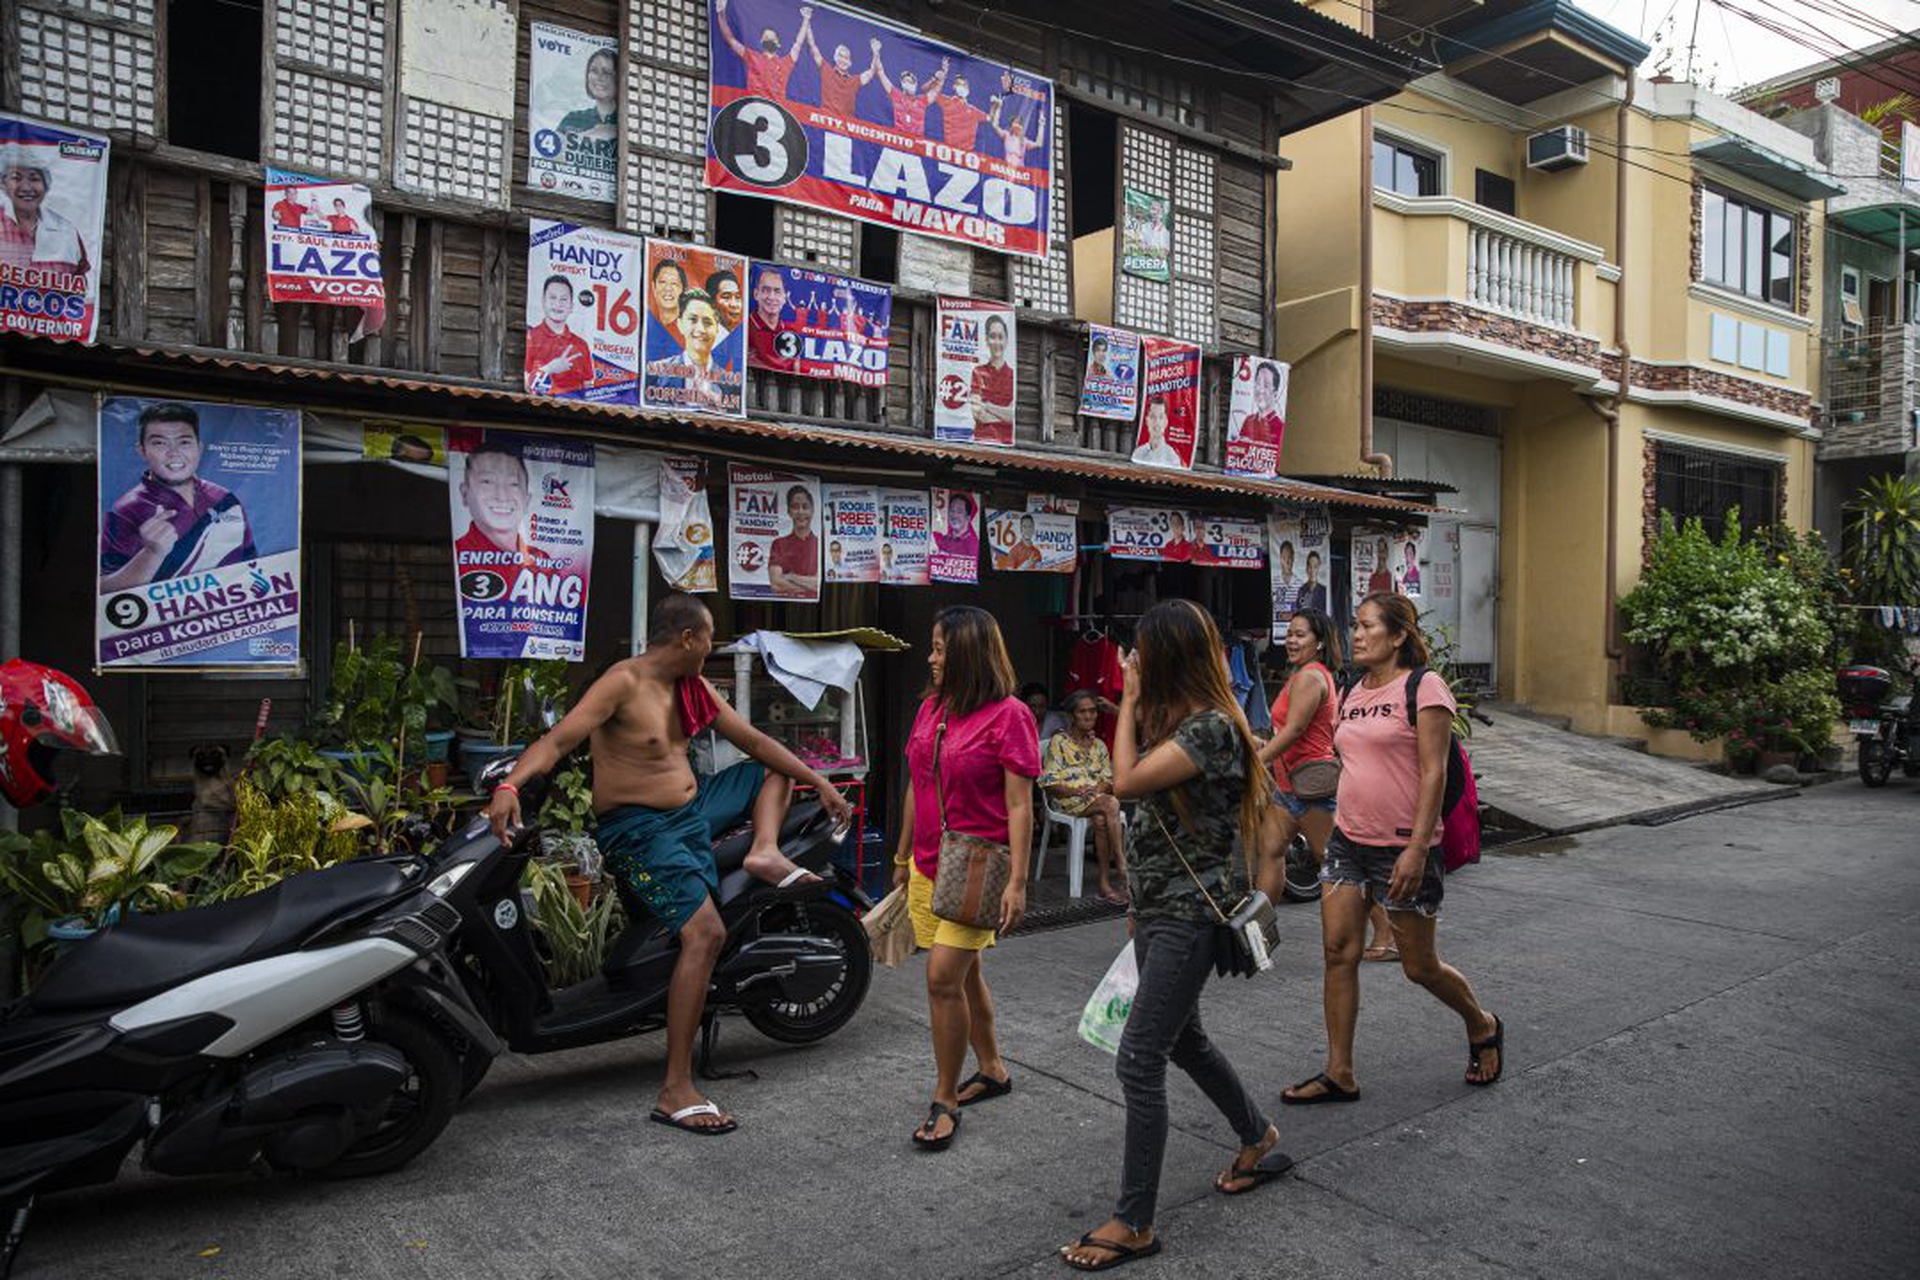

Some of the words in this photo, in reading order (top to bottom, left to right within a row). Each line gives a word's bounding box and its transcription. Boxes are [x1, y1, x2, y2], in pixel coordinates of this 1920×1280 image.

[538, 38, 571, 55] VOTE
[810, 113, 844, 130] ATTY.
[539, 134, 556, 153] 4
[734, 102, 789, 182] 3
[823, 131, 1037, 224] LAZO
[850, 194, 884, 212] PARA
[892, 199, 1005, 244] MAYOR
[297, 236, 328, 248] SAUL
[549, 242, 623, 270] HANDY
[0, 264, 87, 293] CECILIA
[590, 267, 623, 283] LAO
[592, 283, 638, 336] 16
[6, 313, 82, 338] GOVERNOR
[942, 315, 978, 342] FAM
[780, 333, 797, 357] 3
[804, 337, 887, 370] LAZO
[833, 363, 887, 385] MAYOR
[1120, 366, 1129, 379] 7
[939, 380, 968, 402] #2
[735, 487, 779, 514] FAM
[838, 501, 875, 512] ROQUE
[892, 505, 927, 516] ROQUE
[838, 525, 877, 536] ABLAN
[1159, 512, 1170, 532] 3
[890, 528, 928, 540] ABLAN
[995, 520, 1017, 546] 16
[1035, 530, 1073, 543] HANDY
[1113, 530, 1163, 546] LAZO
[1211, 524, 1223, 543] 3
[459, 551, 524, 566] ENRICO
[736, 546, 763, 566] #2
[1218, 545, 1257, 559] LAZO
[148, 574, 221, 600] CHUA
[473, 574, 491, 597] 3
[510, 568, 582, 609] ANG
[114, 601, 137, 625] 9
[463, 606, 506, 620] PARA
[511, 607, 579, 625] KONSEHAL
[114, 630, 164, 656] para
[170, 600, 294, 640] KONSEHAL
[233, 622, 277, 639] LAOAG
